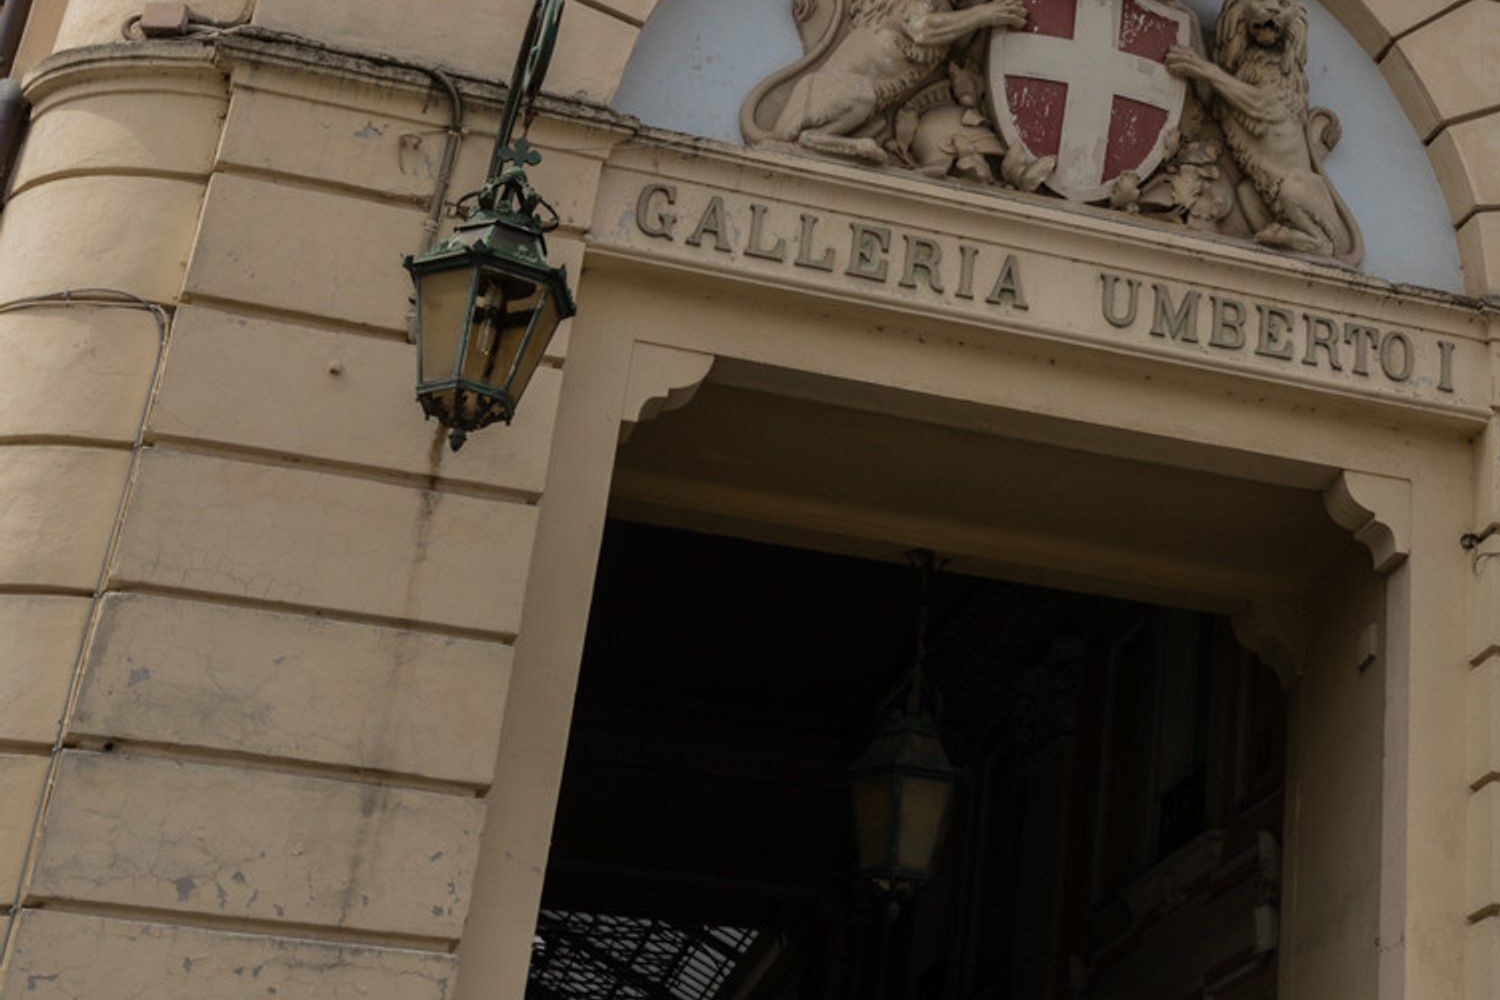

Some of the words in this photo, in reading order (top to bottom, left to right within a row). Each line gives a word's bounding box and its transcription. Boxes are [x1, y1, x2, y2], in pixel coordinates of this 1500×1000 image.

[635, 183, 1030, 311] GALLERIA
[1100, 273, 1415, 382] UMBERTO
[1436, 340, 1456, 393] I
